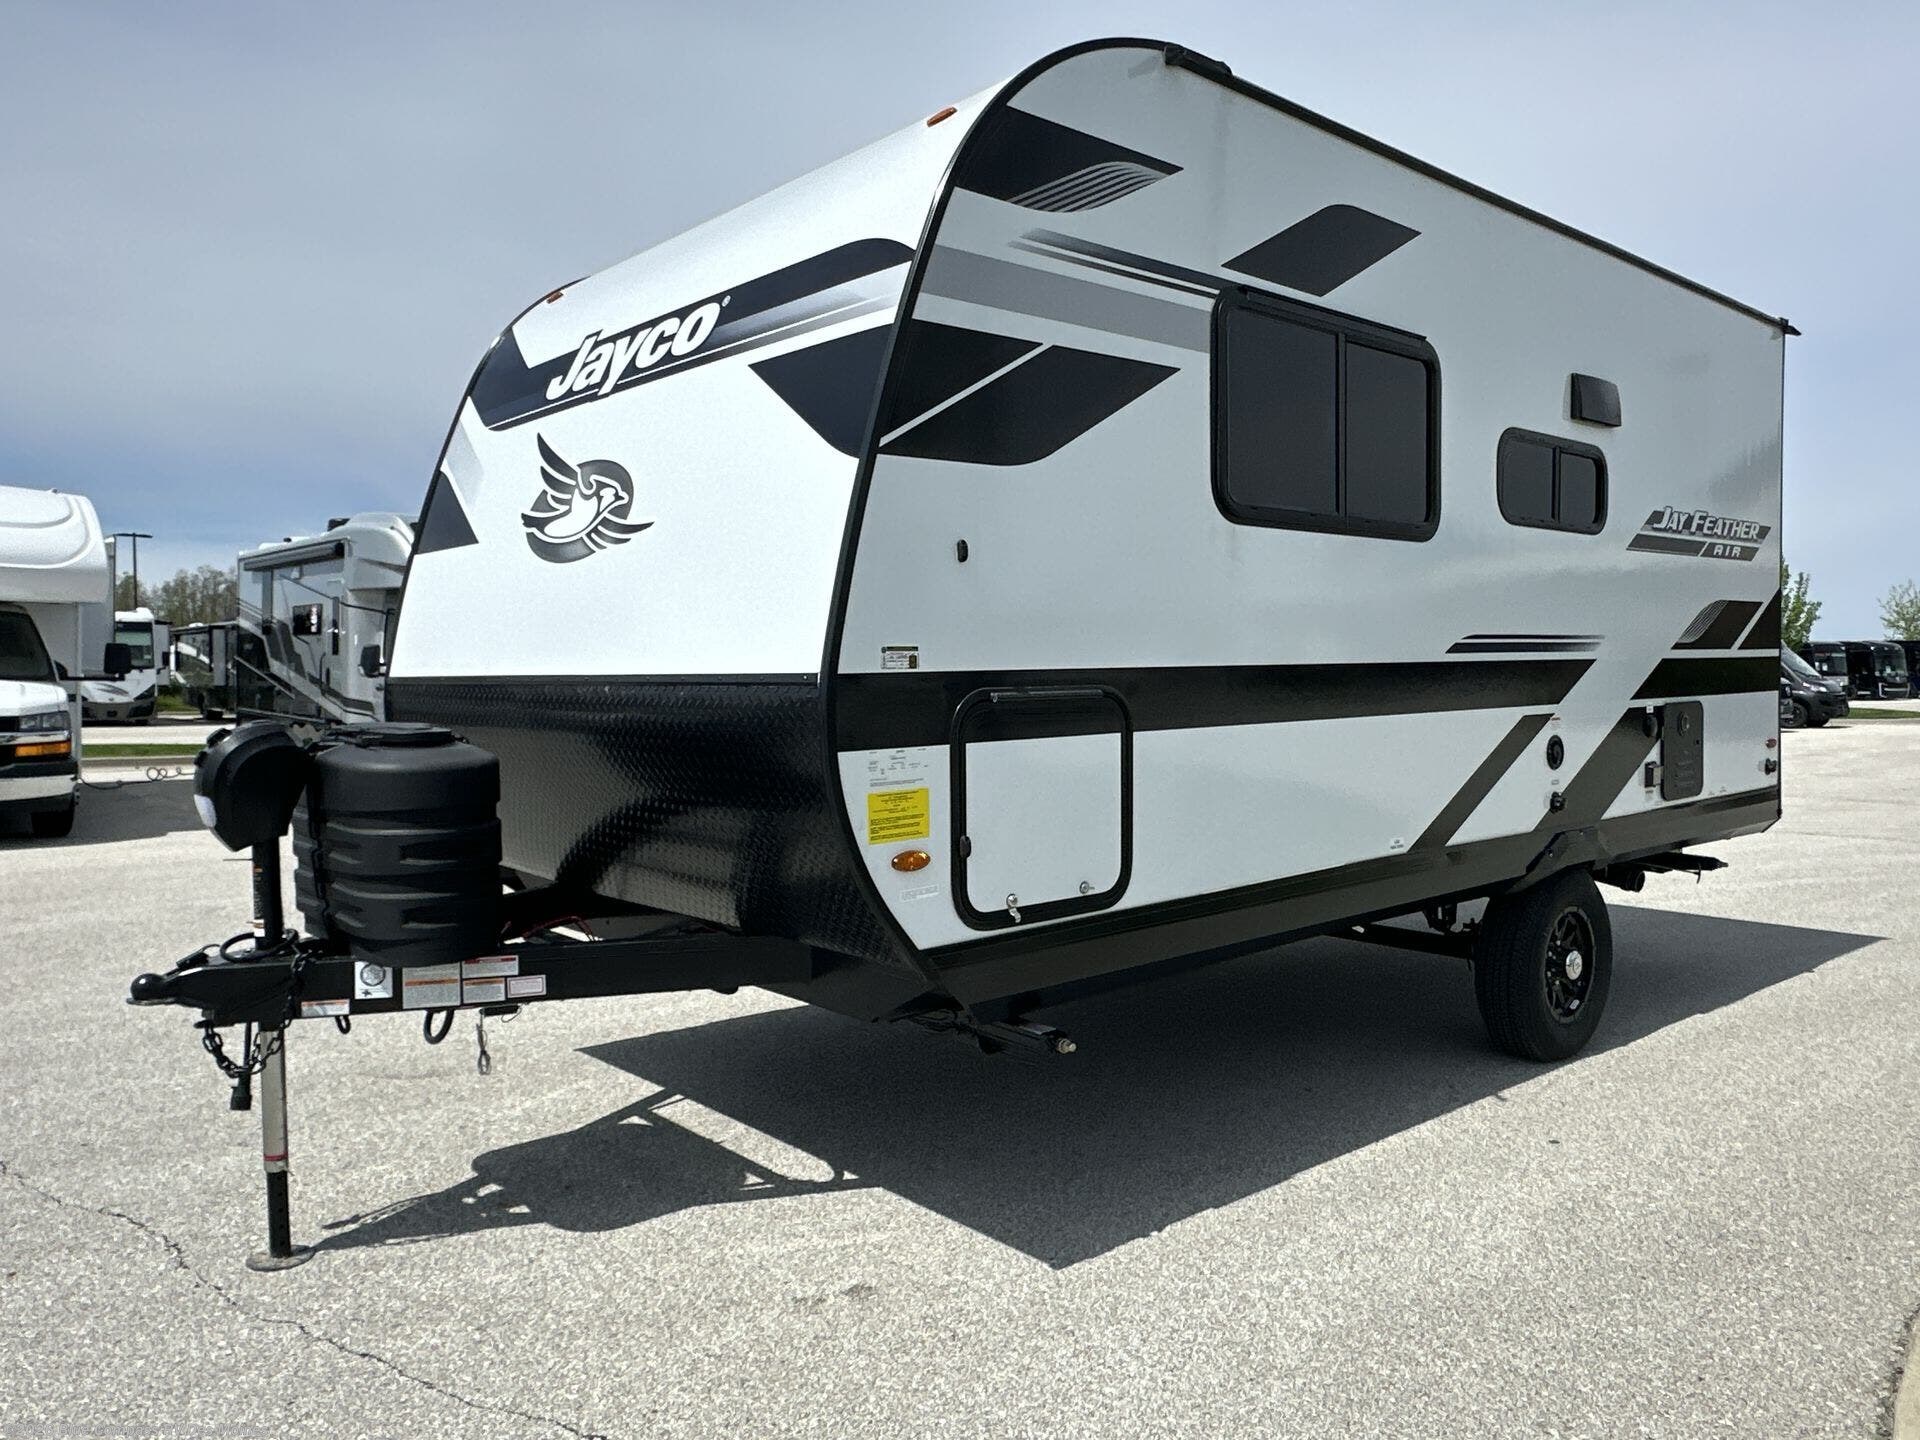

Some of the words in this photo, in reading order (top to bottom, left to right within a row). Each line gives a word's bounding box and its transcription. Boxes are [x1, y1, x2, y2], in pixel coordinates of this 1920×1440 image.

[545, 302, 721, 400] Jayco
[1652, 506, 1689, 532] JAY
[1690, 510, 1760, 540] FEATHER
[1713, 544, 1742, 557] AIR
